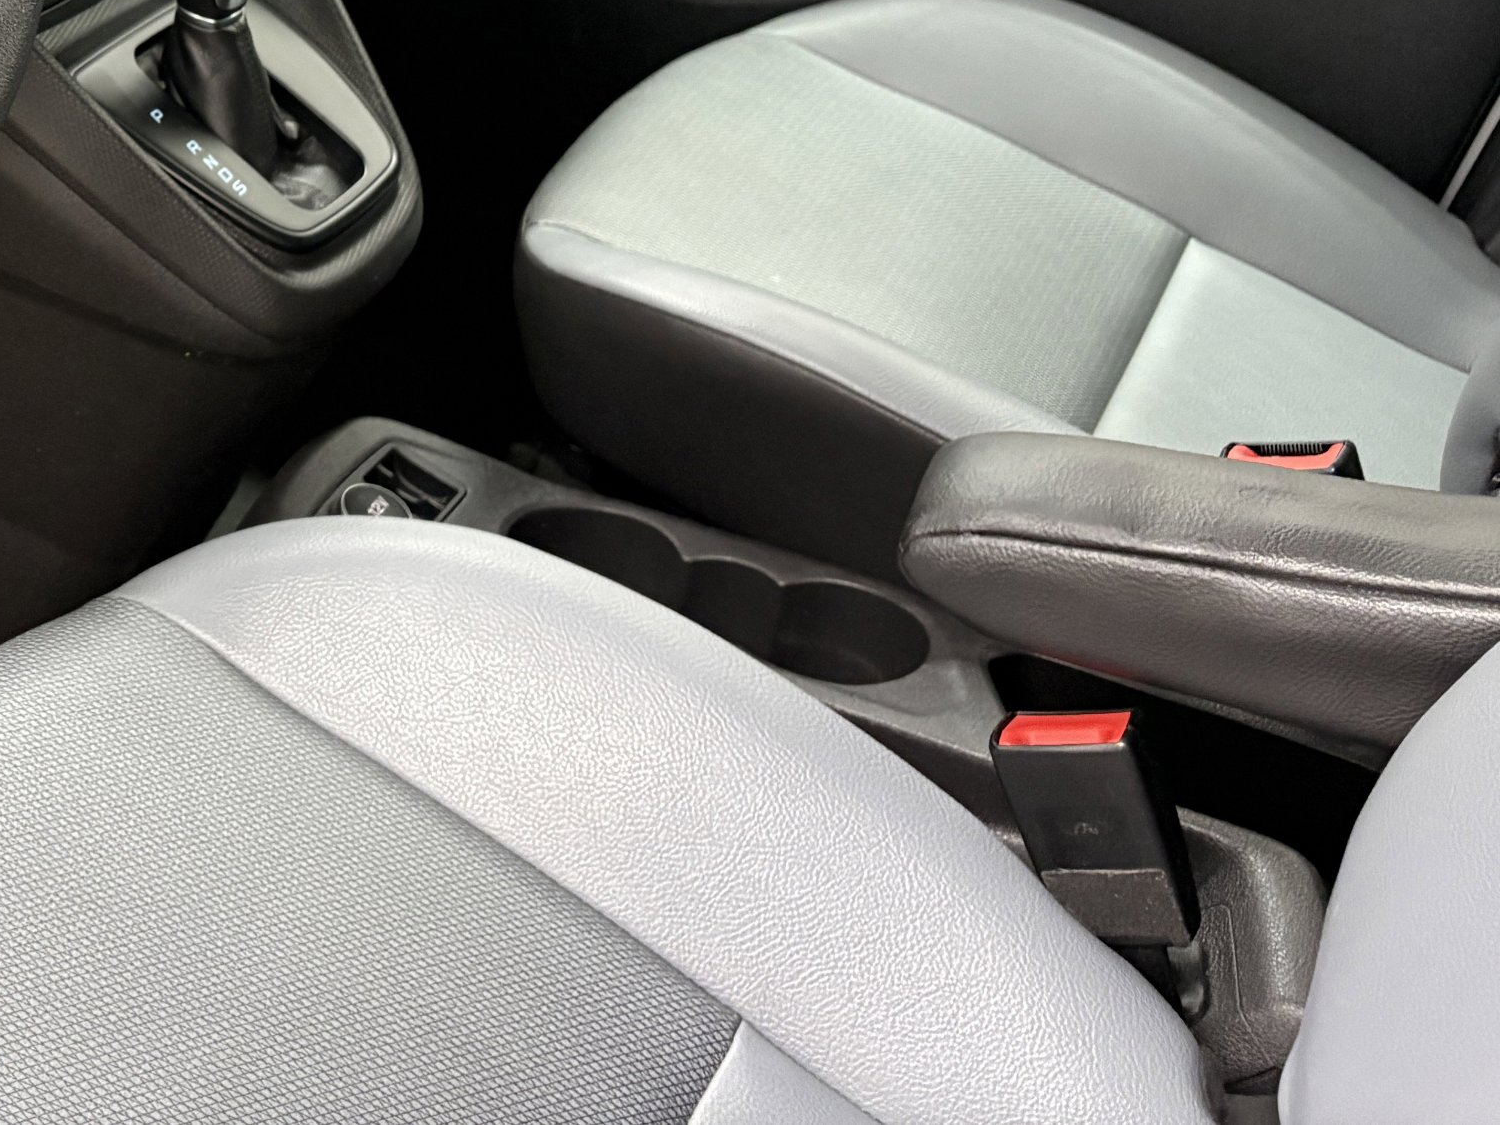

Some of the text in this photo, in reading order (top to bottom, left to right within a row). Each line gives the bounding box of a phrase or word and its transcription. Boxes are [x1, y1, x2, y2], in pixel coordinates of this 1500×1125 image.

[149, 108, 248, 196] P R N D S
